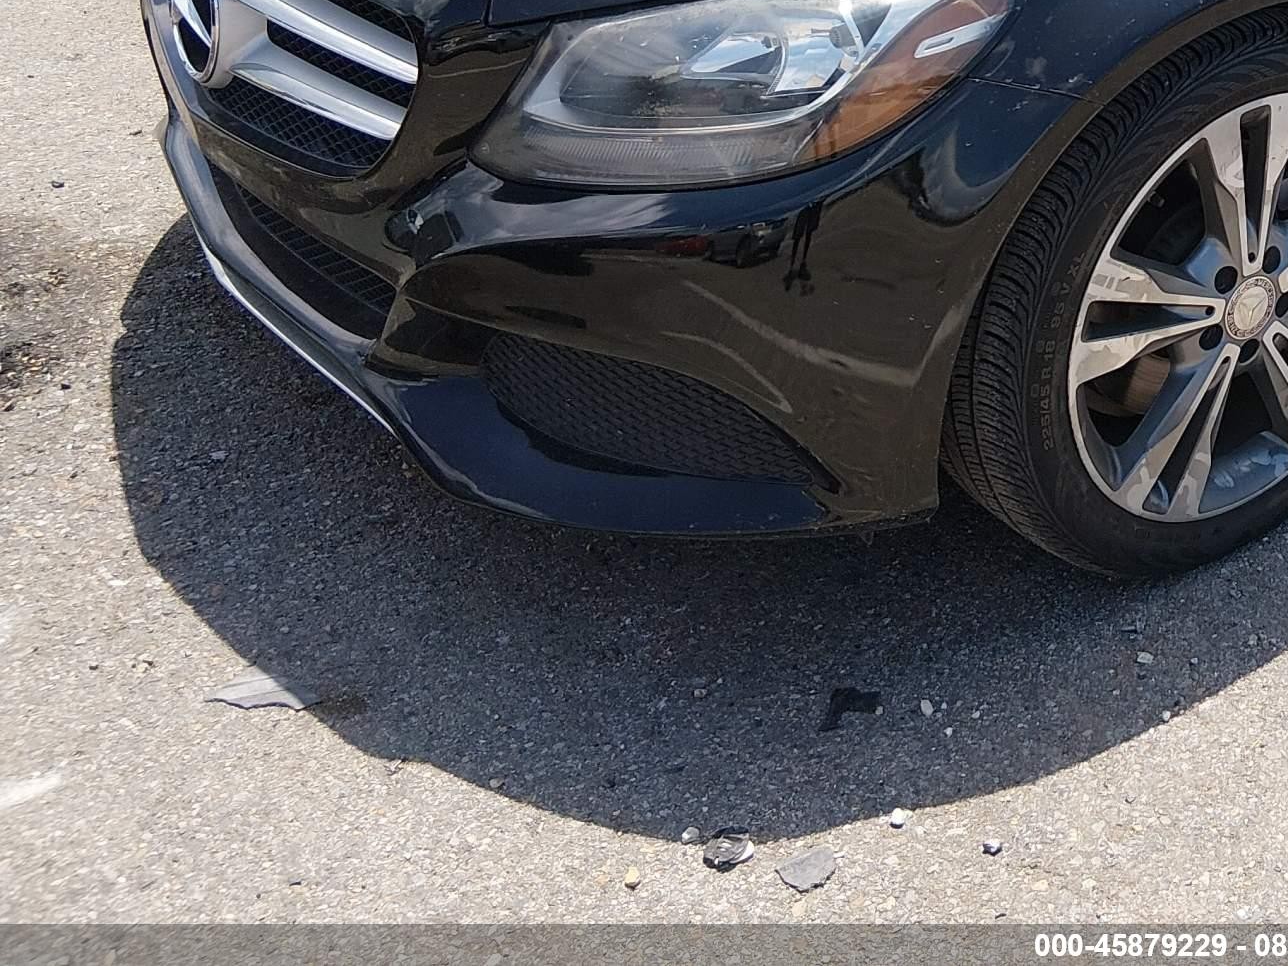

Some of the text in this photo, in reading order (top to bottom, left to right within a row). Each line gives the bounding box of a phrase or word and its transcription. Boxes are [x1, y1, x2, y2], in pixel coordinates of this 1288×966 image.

[1067, 251, 1086, 278] XL
[1043, 340, 1056, 360] 18
[1041, 365, 1052, 379] R
[1040, 385, 1055, 451] 225/45
